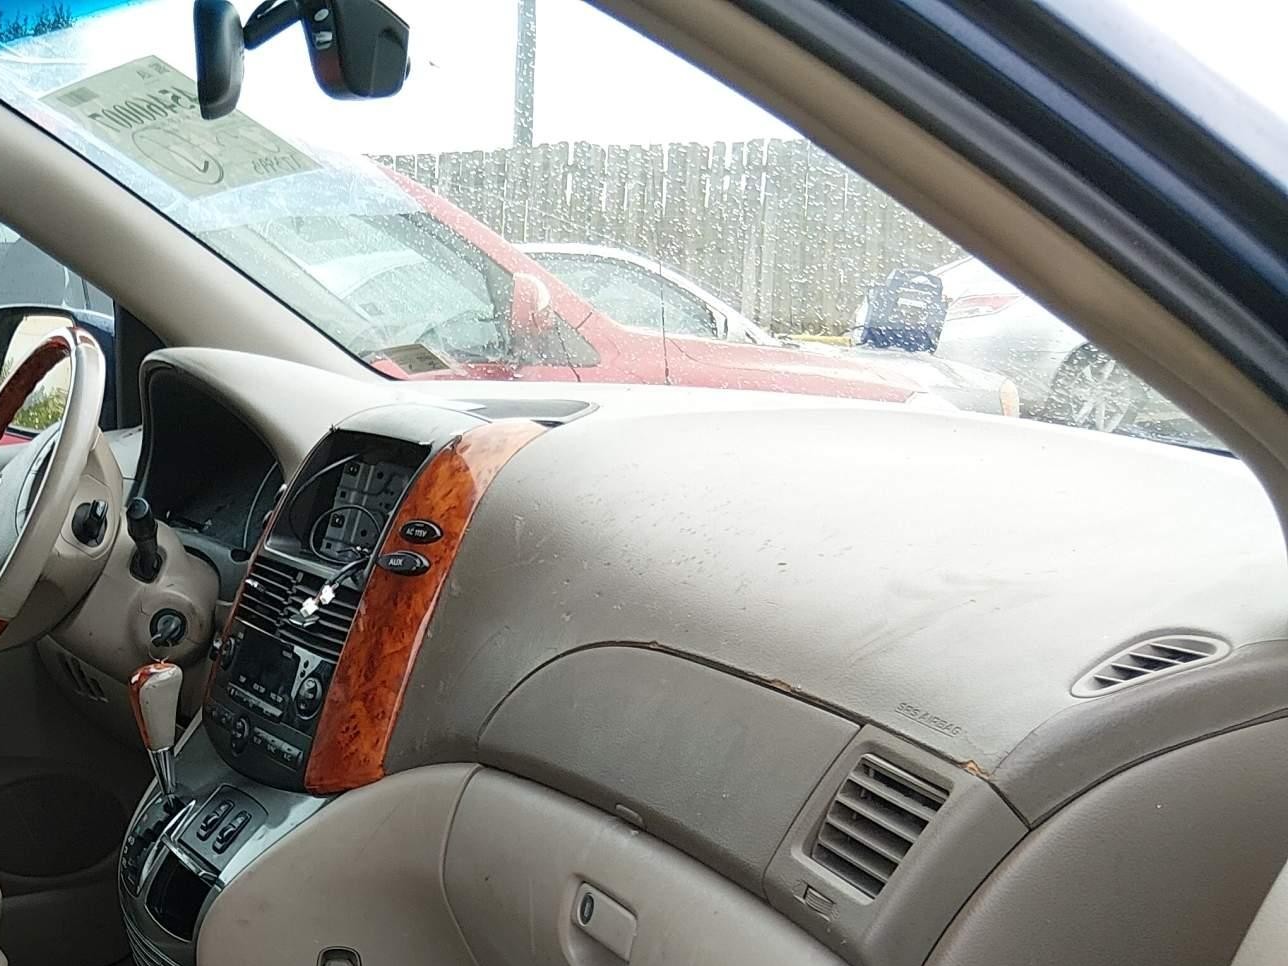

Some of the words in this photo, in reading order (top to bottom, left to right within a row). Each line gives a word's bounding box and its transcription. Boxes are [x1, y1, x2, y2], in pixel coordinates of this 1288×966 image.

[388, 558, 404, 566] AUX
[896, 702, 921, 717] SRS
[918, 712, 963, 736] AIRBAG
